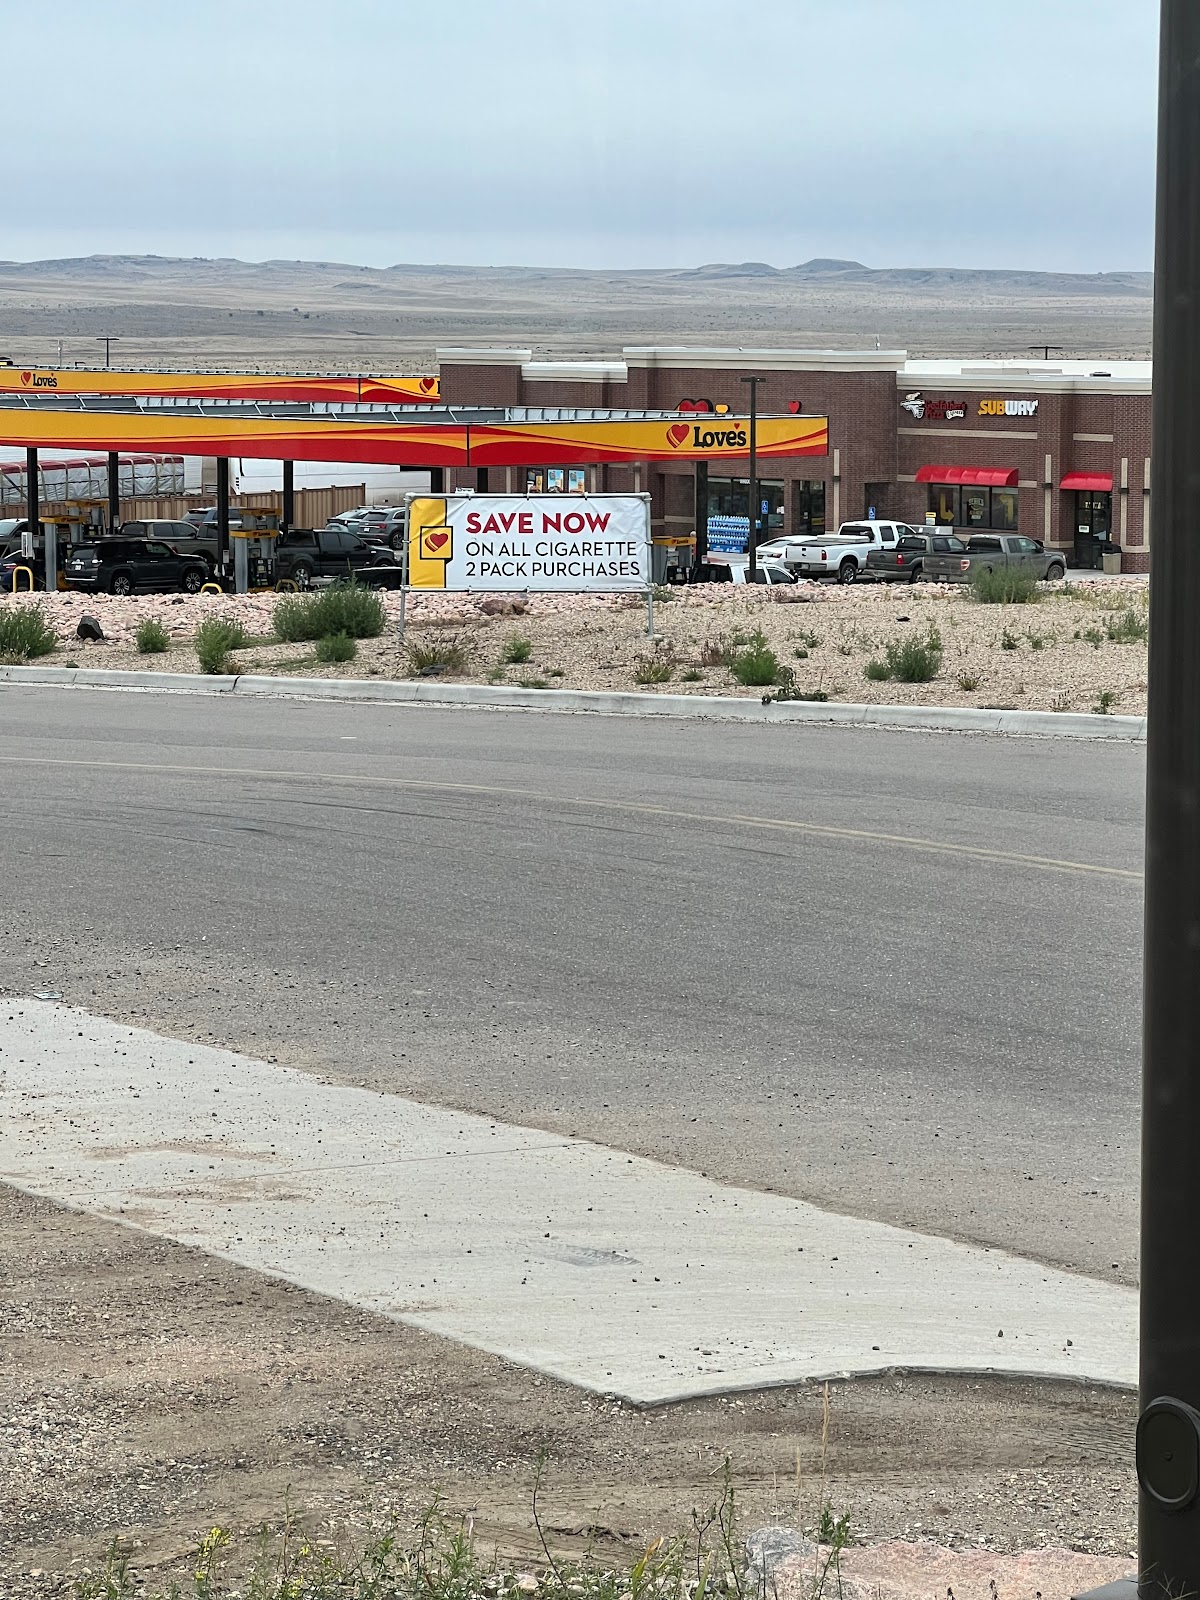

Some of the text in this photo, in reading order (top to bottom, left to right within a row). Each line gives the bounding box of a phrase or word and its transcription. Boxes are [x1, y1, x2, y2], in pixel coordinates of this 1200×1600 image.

[977, 399, 1039, 416] SUBWAY
[465, 512, 612, 534] SAVE NOW
[465, 541, 637, 557] ON ALL CIGARETTE
[465, 561, 640, 577] 2 PACK PURCHASES
